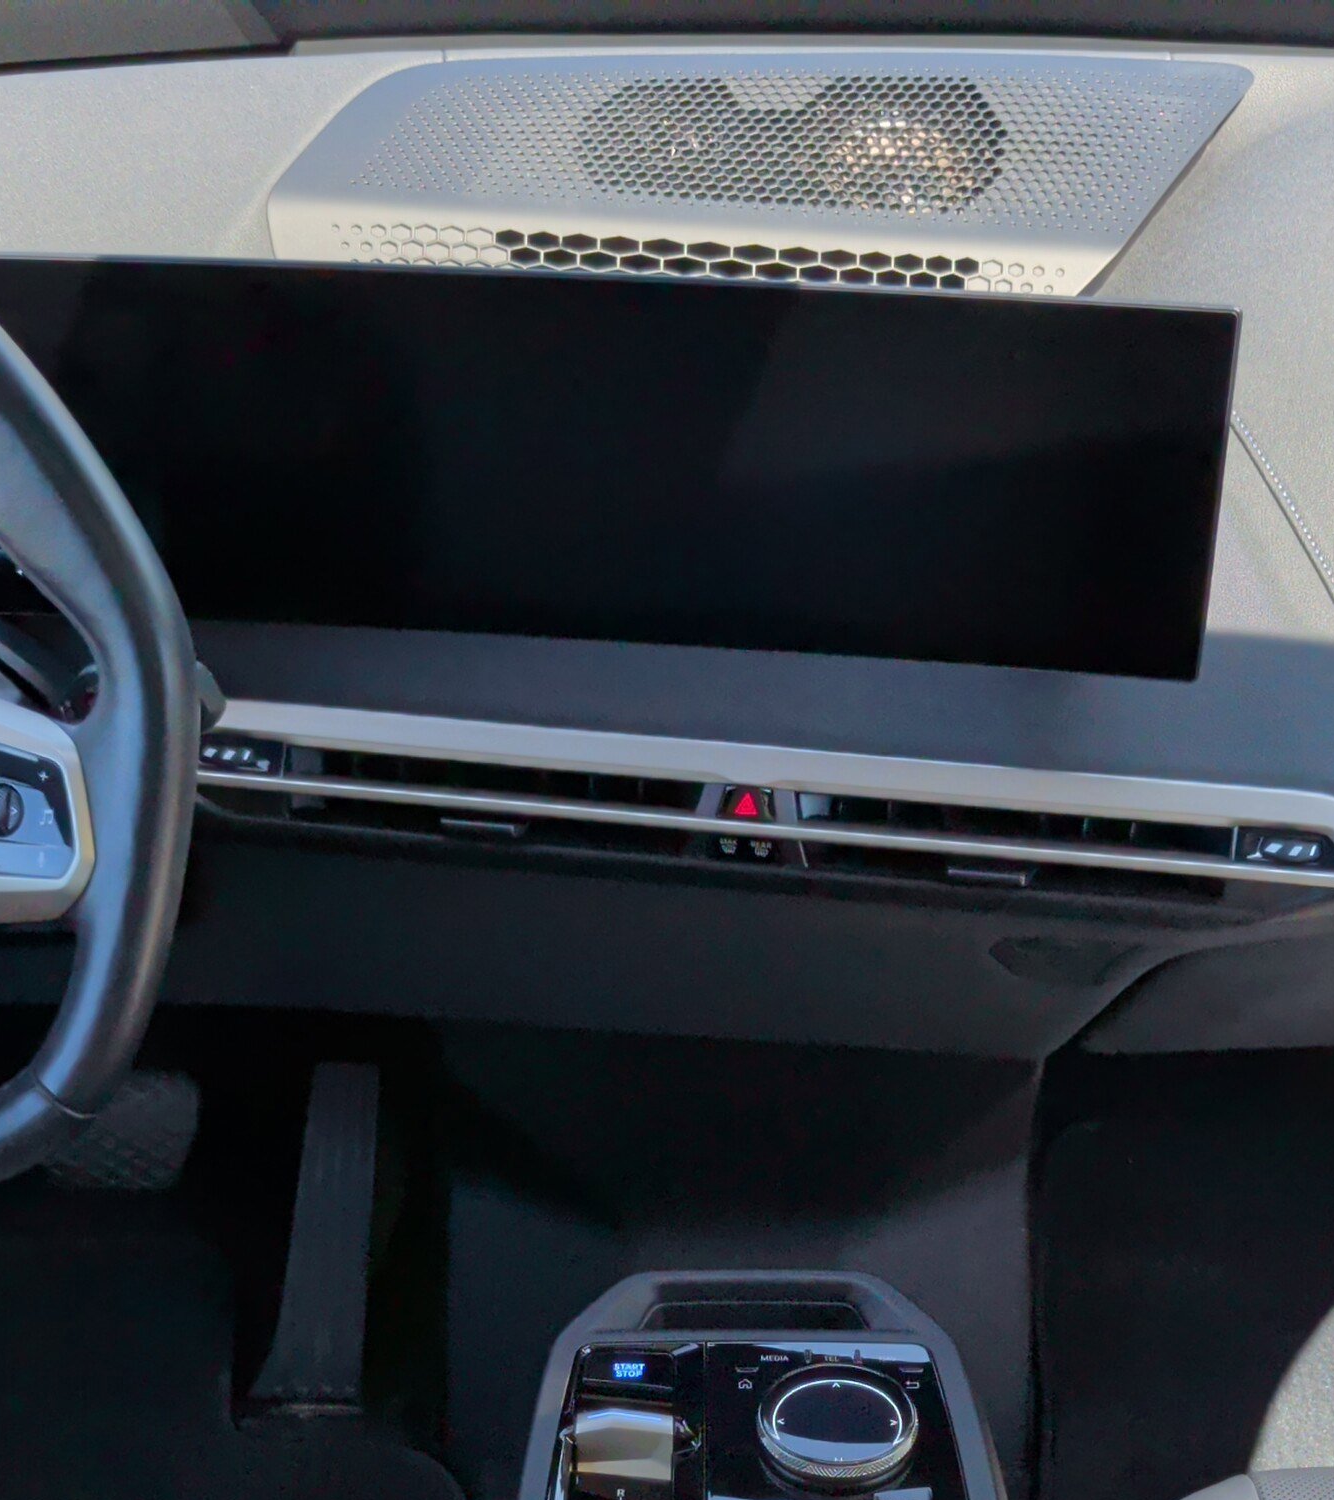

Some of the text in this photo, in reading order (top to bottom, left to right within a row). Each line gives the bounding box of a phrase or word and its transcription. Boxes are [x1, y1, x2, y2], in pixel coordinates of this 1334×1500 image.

[760, 1354, 789, 1363] MEDIA
[613, 1363, 646, 1371] START
[615, 1370, 643, 1378] STOP
[617, 1488, 626, 1498] R
